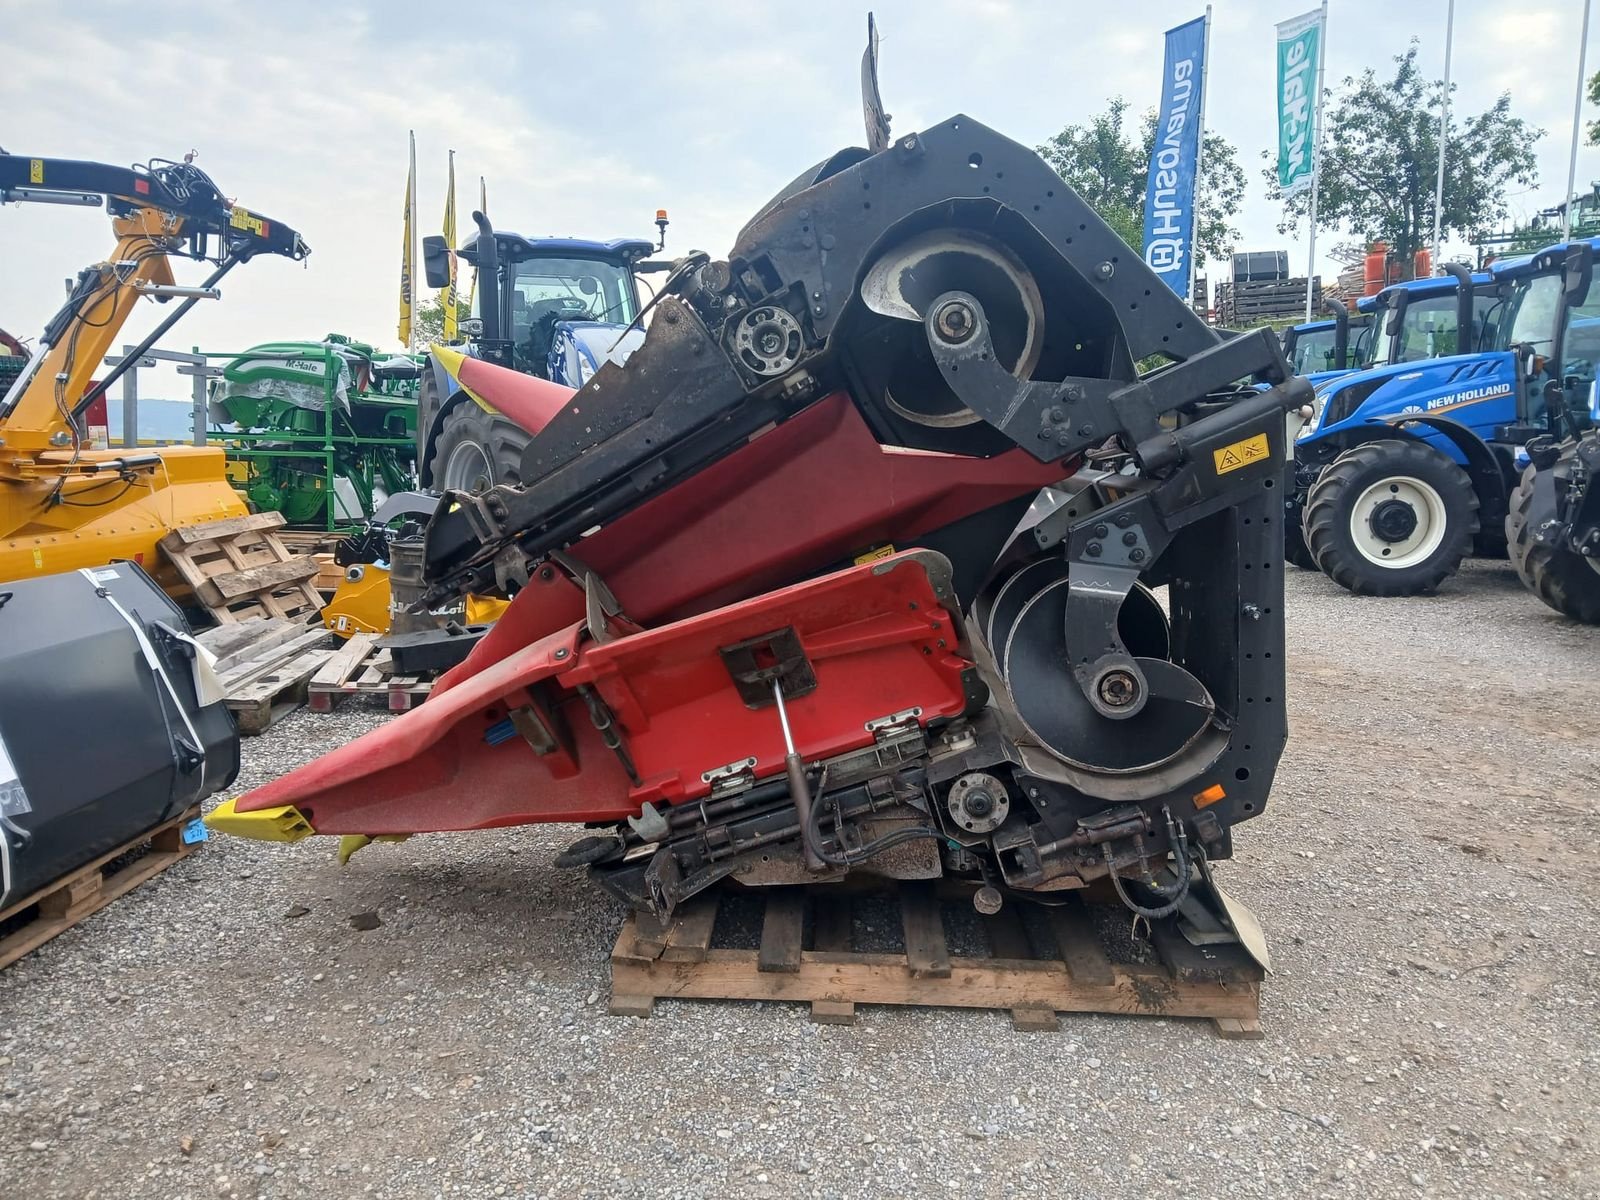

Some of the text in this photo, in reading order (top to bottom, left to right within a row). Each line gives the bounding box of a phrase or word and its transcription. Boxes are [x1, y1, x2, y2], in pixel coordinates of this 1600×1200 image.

[285, 359, 317, 372] McHale
[1427, 383, 1511, 410] NEW HOLLAND
